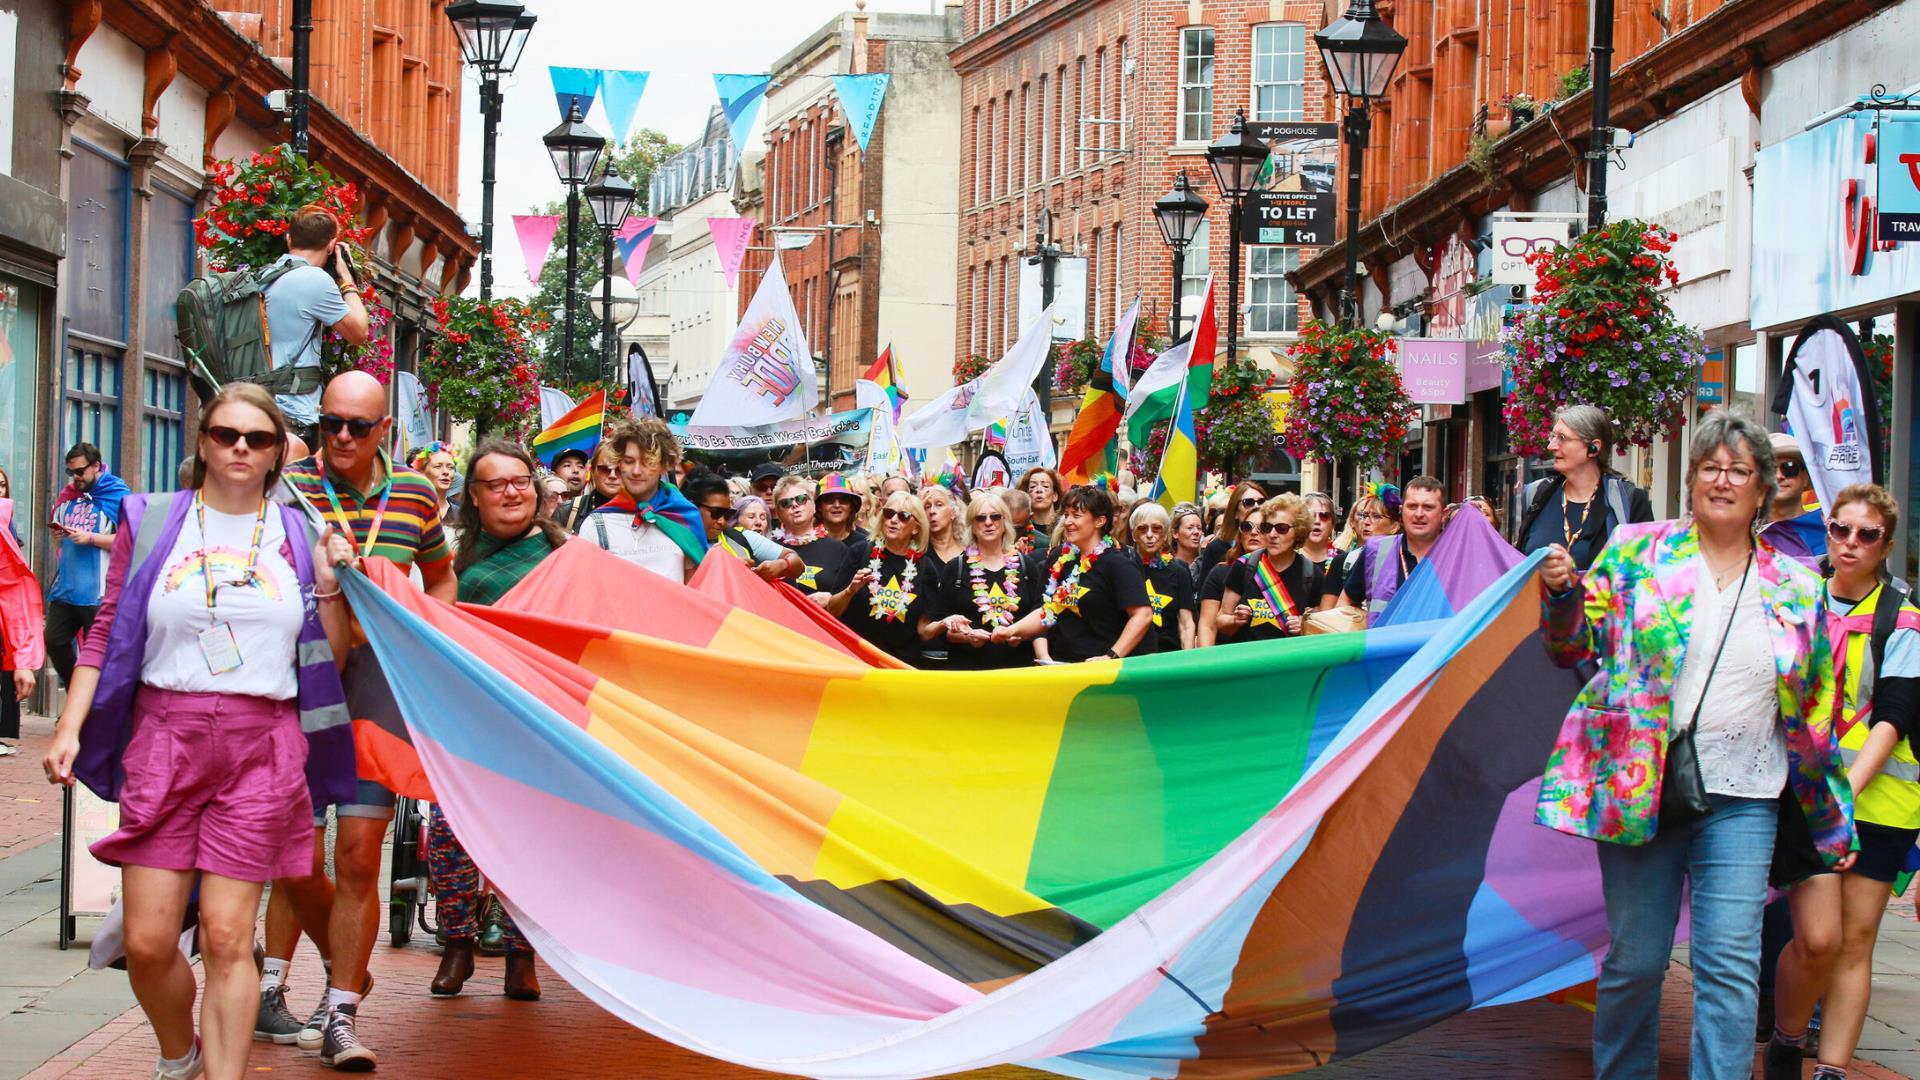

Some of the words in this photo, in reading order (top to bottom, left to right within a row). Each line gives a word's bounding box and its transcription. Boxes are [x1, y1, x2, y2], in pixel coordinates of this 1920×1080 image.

[861, 78, 884, 137] READING
[1273, 127, 1318, 135] DOGHOUSE
[1260, 207, 1282, 219] TO
[1286, 207, 1317, 220] LET
[728, 221, 753, 272] READING
[1408, 351, 1458, 366] NAILS
[1416, 377, 1450, 387] Beauty
[694, 434, 710, 447] To
[710, 435, 727, 448] Be
[725, 434, 759, 447] Trans
[759, 432, 776, 445] In
[774, 429, 808, 443] West
[810, 458, 844, 470] Therapy
[1007, 455, 1027, 465] South
[1252, 609, 1275, 619] CHO
